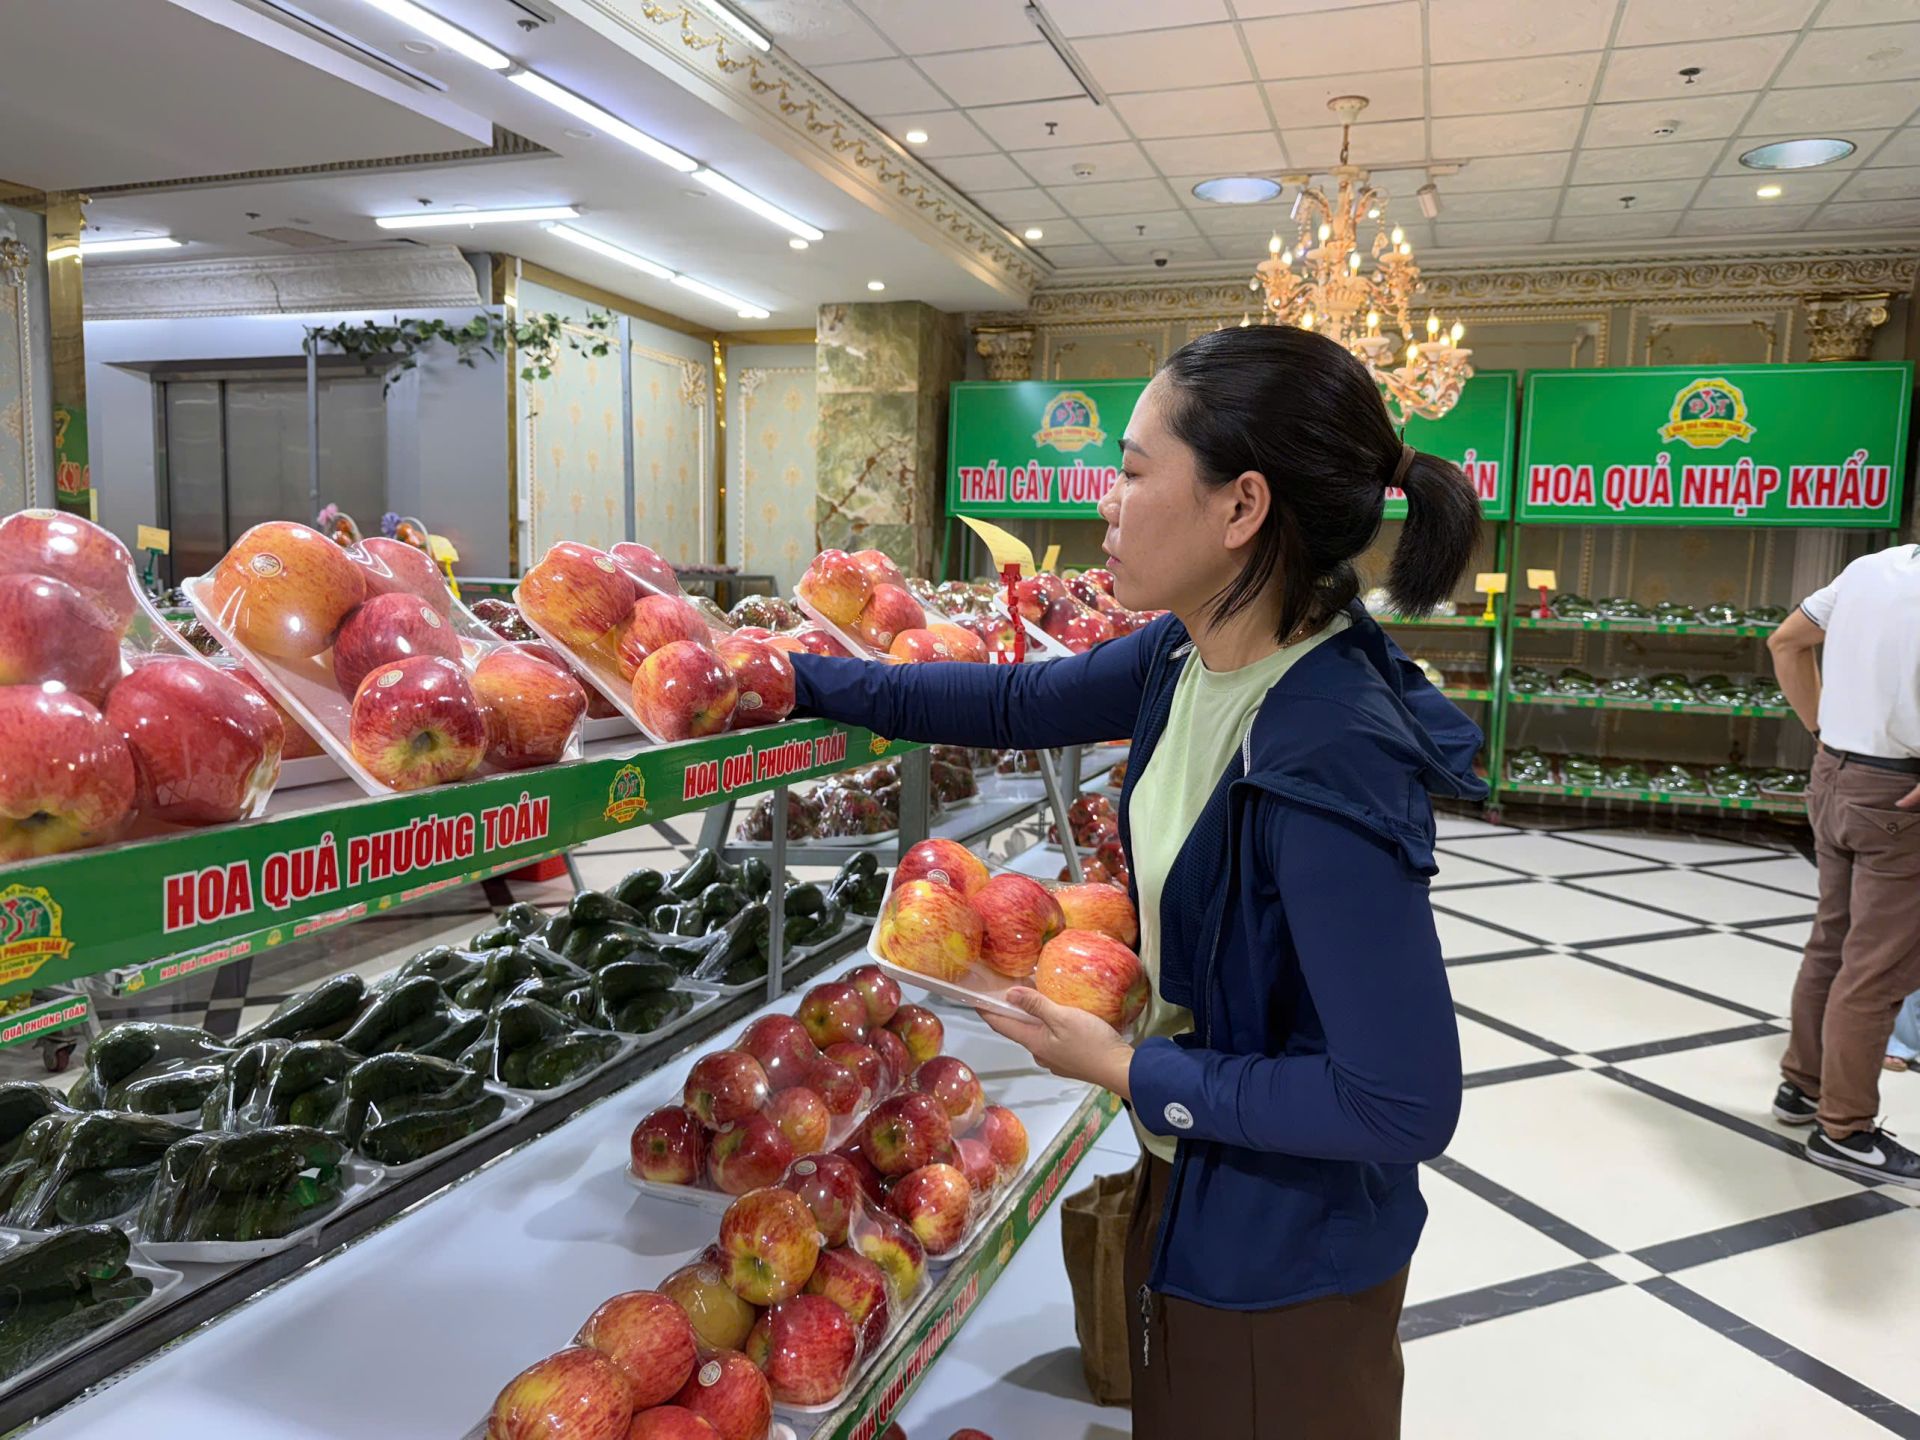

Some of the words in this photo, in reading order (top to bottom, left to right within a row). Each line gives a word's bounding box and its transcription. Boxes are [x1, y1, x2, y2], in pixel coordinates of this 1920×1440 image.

[958, 459, 1006, 502] TRÁI
[1011, 460, 1054, 503] CÂY
[1450, 448, 1499, 501] ẢN
[1528, 464, 1595, 506] HOA
[1603, 452, 1673, 511] QUẢ
[1681, 456, 1780, 517] NHẬP
[1787, 449, 1891, 509] KHẨU
[684, 759, 719, 801] HOA
[722, 745, 754, 793] QUẢ
[757, 738, 812, 783] PHƯƠNG
[164, 860, 255, 933] HOA
[262, 831, 340, 911] QUẢ
[347, 812, 475, 887] PHƯƠNG
[481, 791, 551, 851] TOẢN
[3, 1022, 24, 1041] QUẢ
